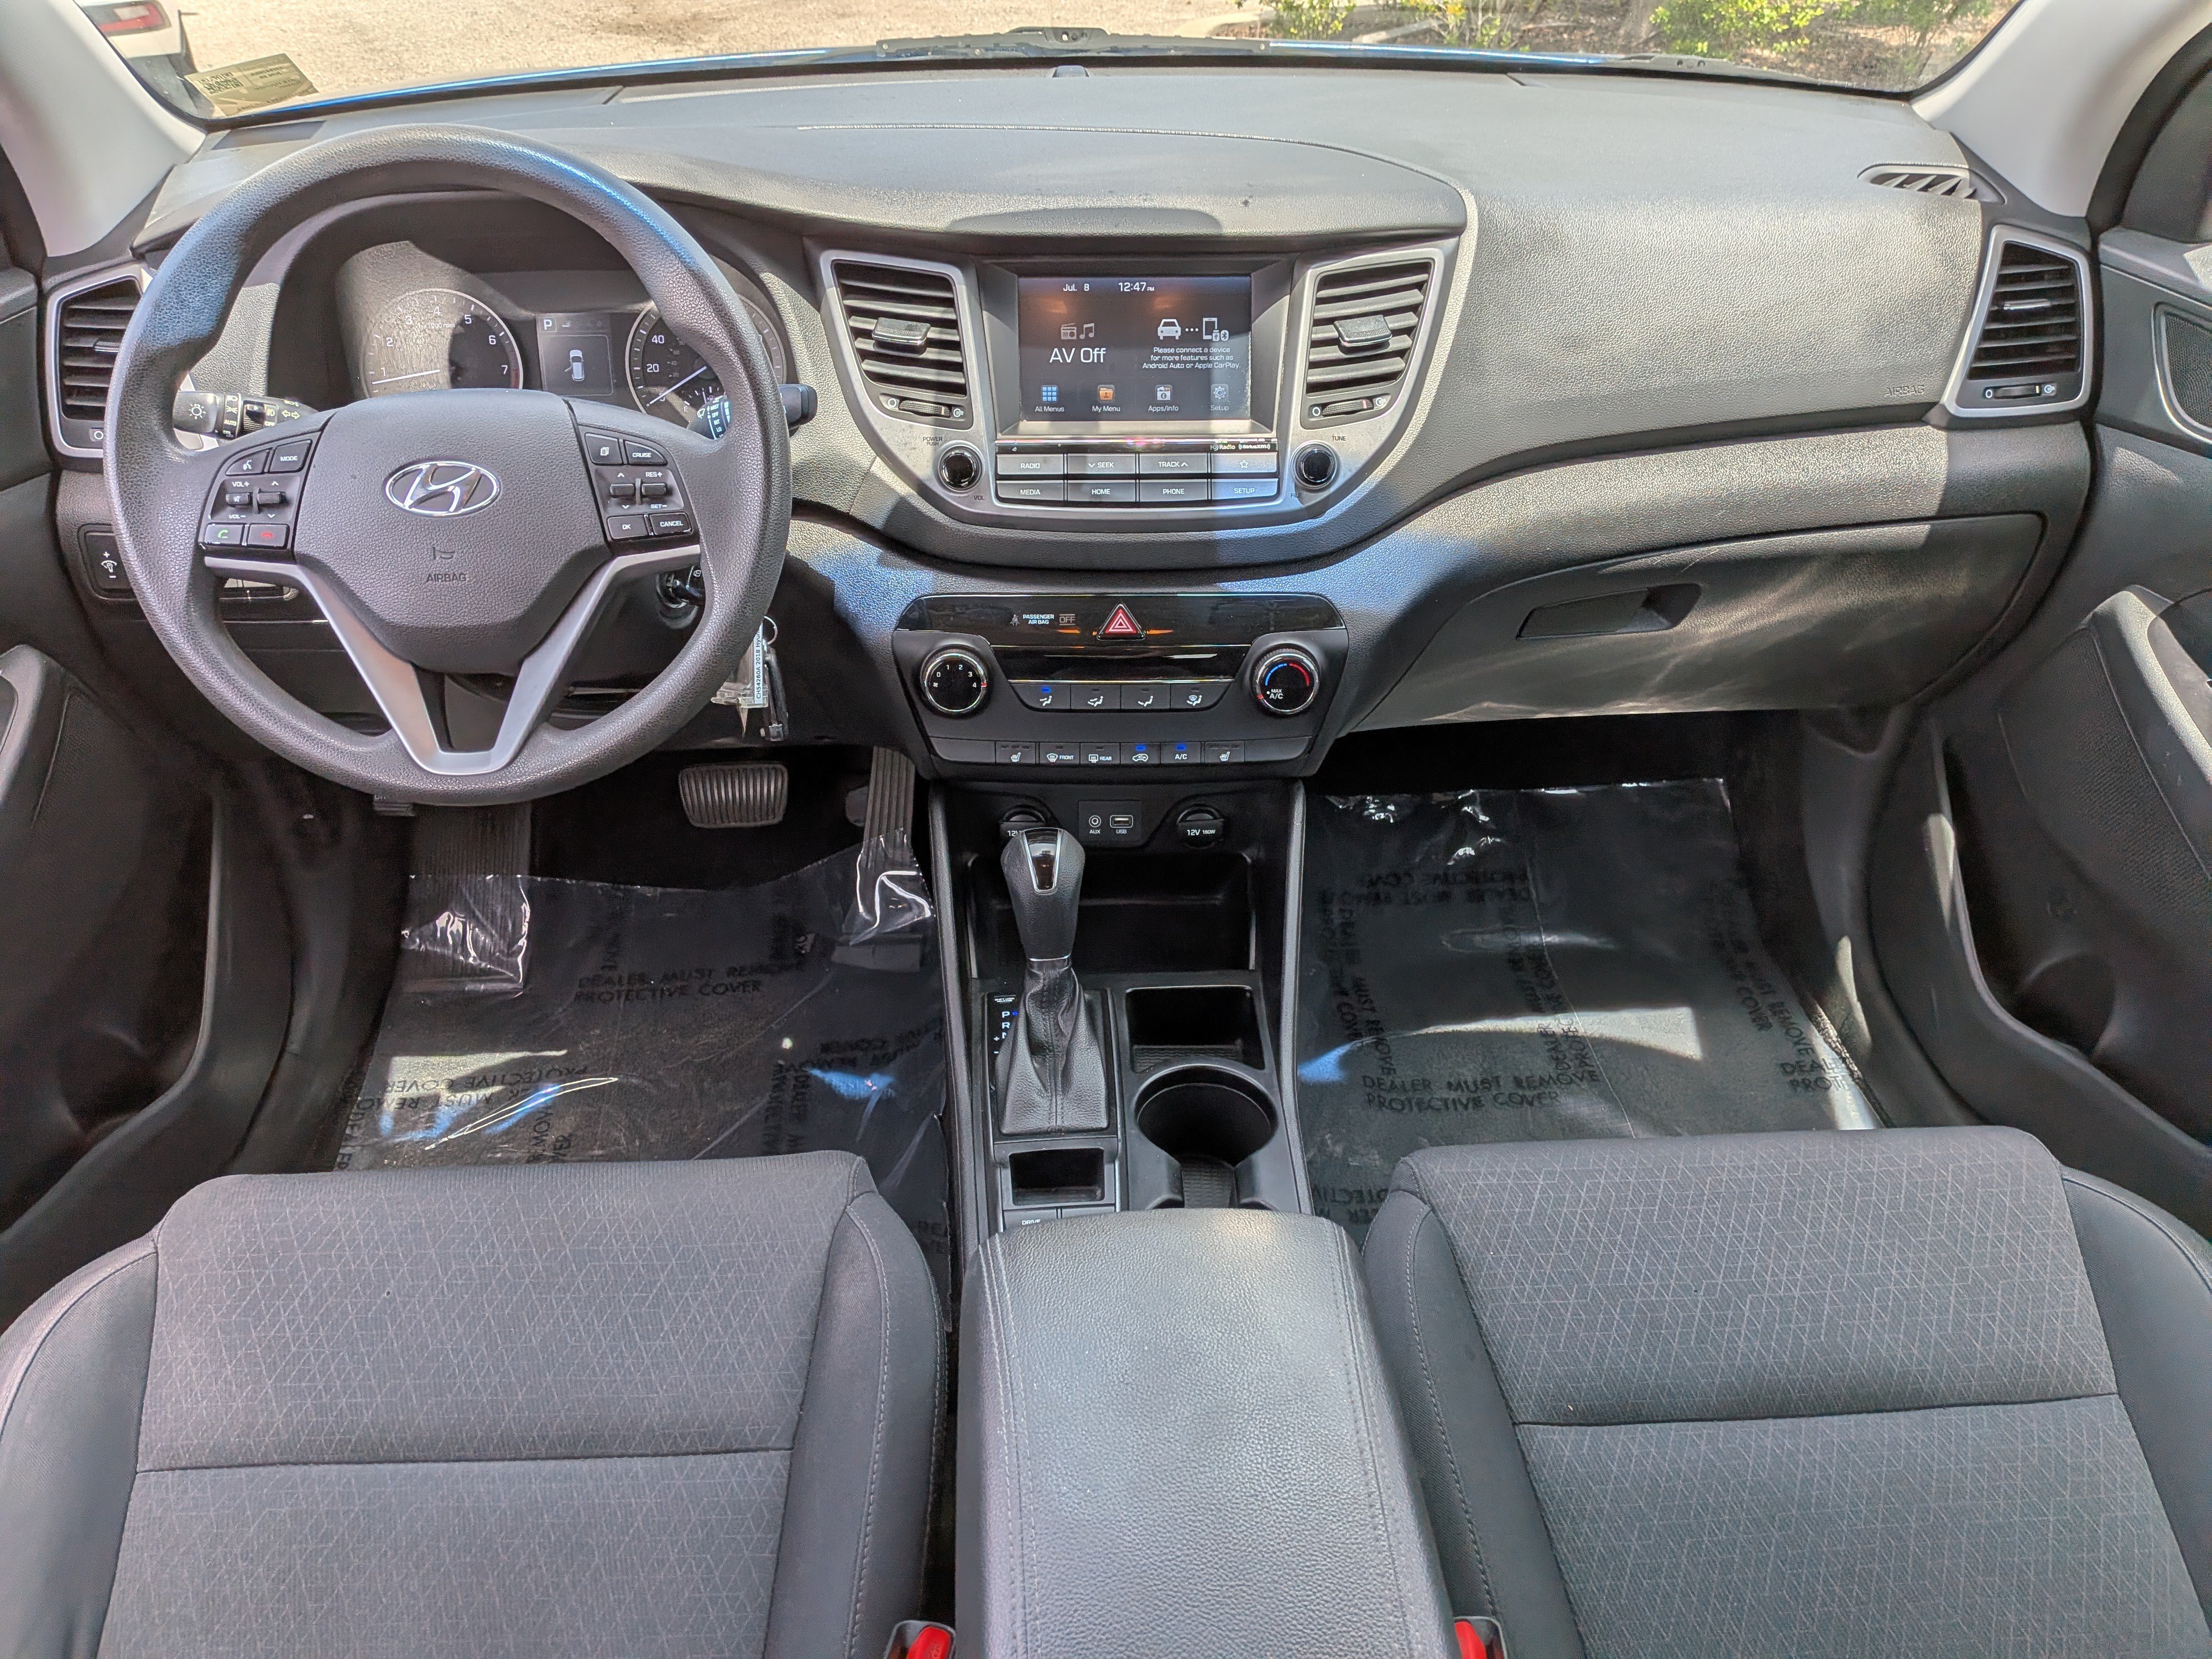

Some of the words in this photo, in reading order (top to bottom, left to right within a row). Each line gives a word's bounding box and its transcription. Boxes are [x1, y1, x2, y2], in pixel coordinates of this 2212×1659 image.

[1084, 283, 1089, 291] 8
[1118, 282, 1146, 291] 12:47
[434, 306, 440, 315] 4
[405, 315, 413, 325] 3
[465, 314, 472, 324] 5
[543, 319, 552, 330] P
[387, 337, 394, 347] 2
[488, 335, 496, 345] 6
[651, 335, 665, 344] 40
[1049, 347, 1074, 363] AV
[1080, 347, 1106, 363] Off
[501, 365, 508, 374] 7
[646, 363, 659, 373] 20
[1884, 385, 1924, 398] AIRBAG
[426, 573, 467, 583] AIRBAG
[660, 967, 715, 985] MUST
[697, 979, 763, 998] COVER
[1735, 986, 1773, 1032] COVER
[1767, 1001, 1816, 1056] REMOVE
[466, 1065, 589, 1091] PROTECTIVE
[1361, 1074, 1432, 1093] DEALER
[1446, 1075, 1501, 1094] MUST
[1513, 1070, 1600, 1092] REMOVE
[387, 1078, 455, 1094] COVER
[1366, 1094, 1485, 1113] PROTECTIVE
[1492, 1091, 1559, 1108] COVER
